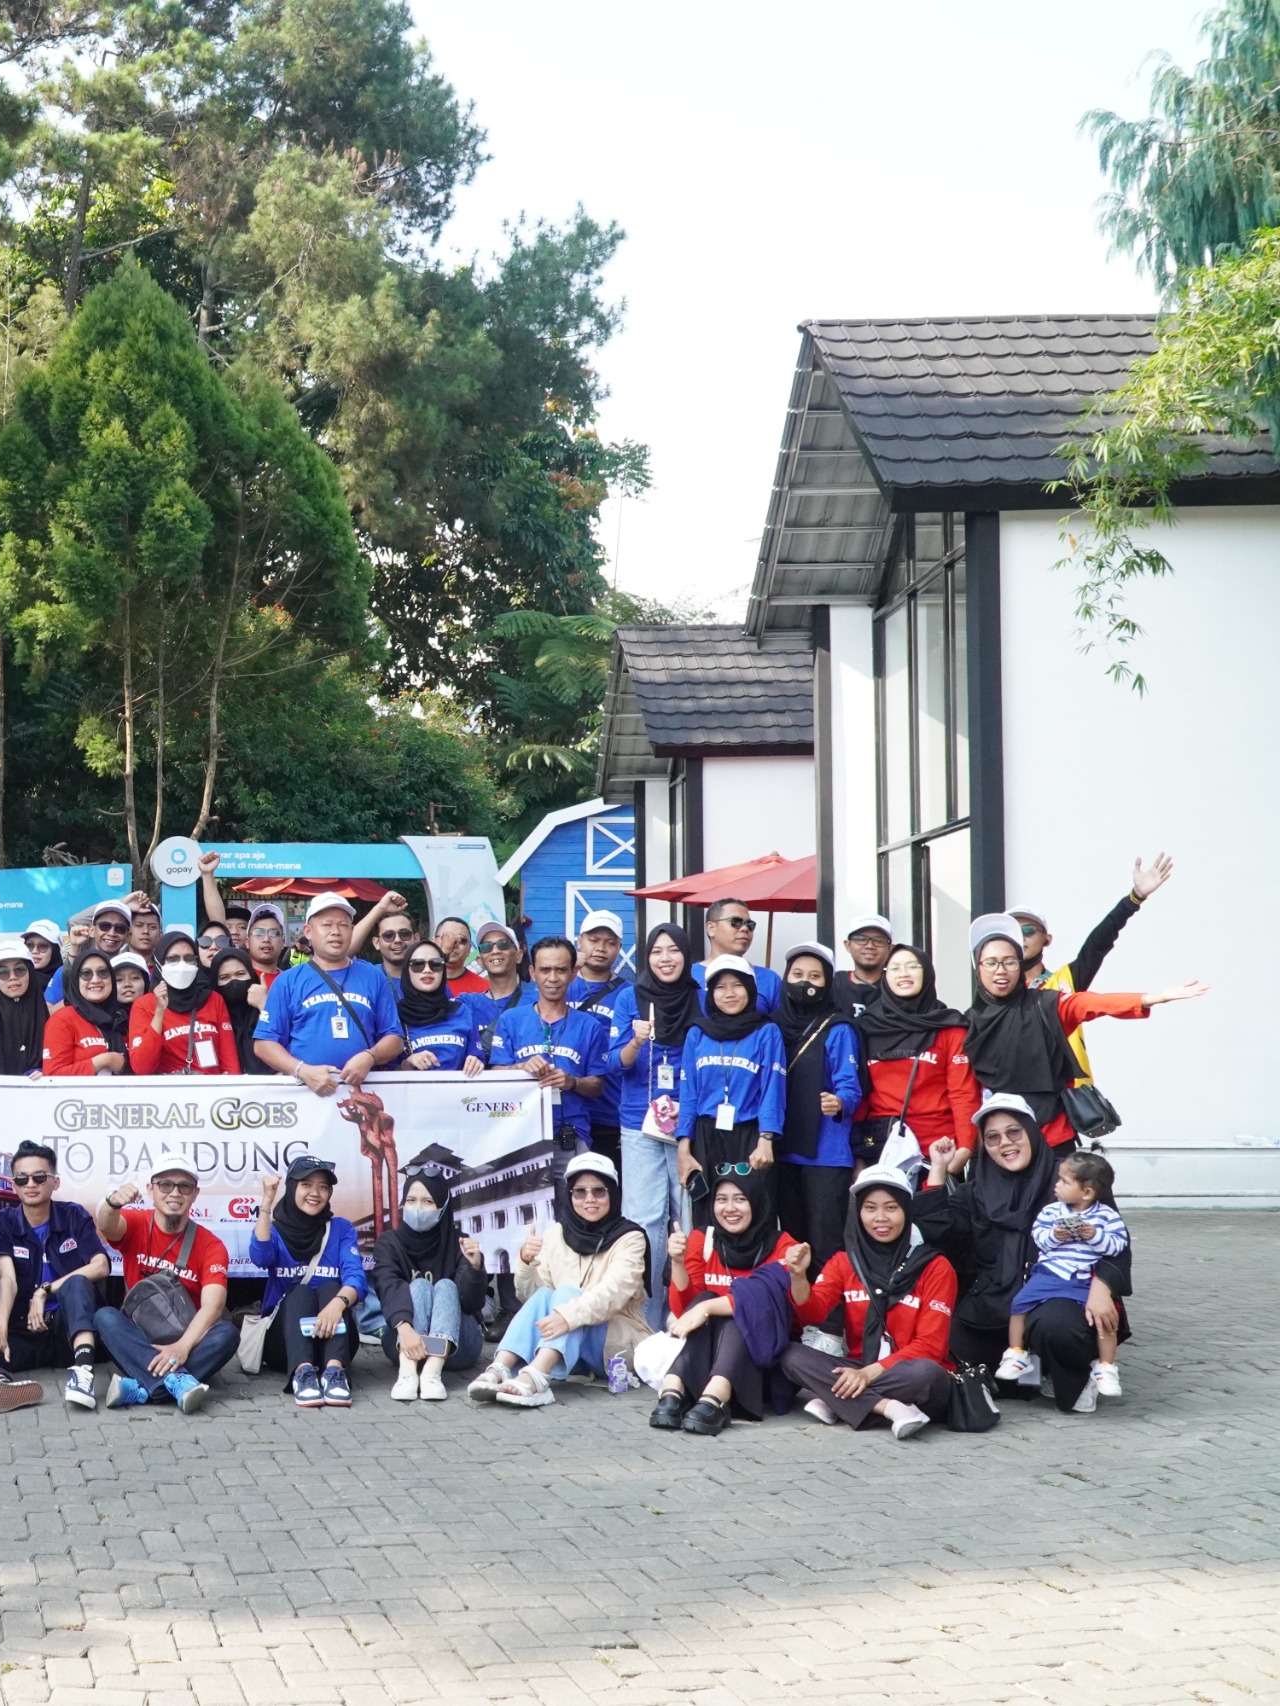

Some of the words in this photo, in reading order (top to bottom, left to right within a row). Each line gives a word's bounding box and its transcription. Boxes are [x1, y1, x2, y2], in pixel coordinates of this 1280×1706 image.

[166, 866, 193, 875] gopay
[54, 1098, 205, 1131] GENERAL
[210, 1097, 299, 1131] GOES
[42, 1135, 94, 1176] TO
